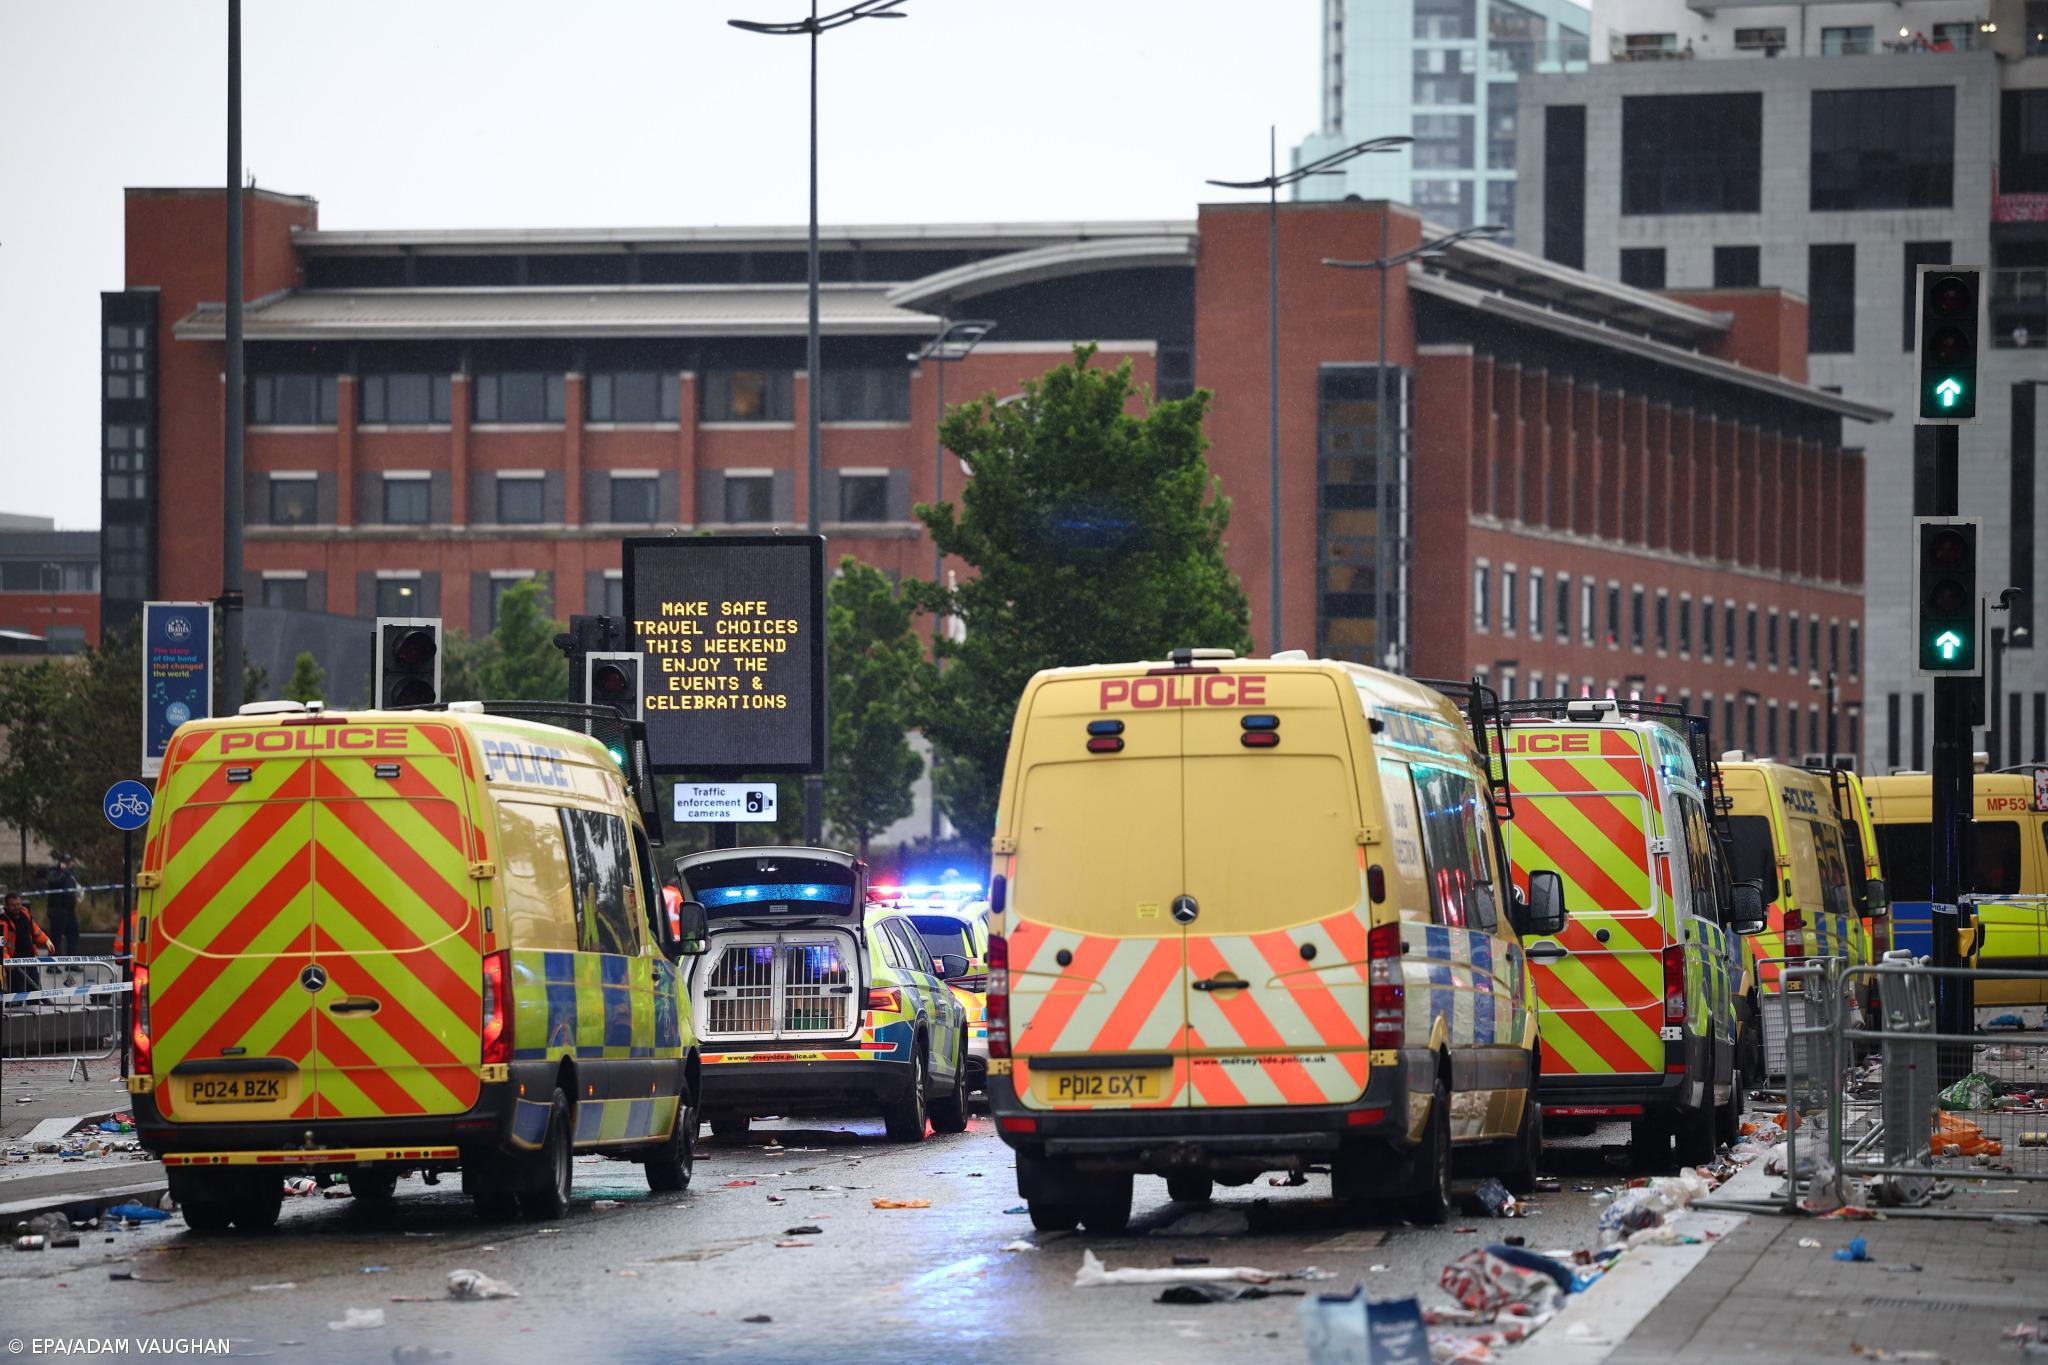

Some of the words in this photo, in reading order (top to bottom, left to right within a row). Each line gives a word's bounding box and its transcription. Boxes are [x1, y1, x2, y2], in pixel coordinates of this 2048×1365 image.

[662, 602, 708, 616] MAKE
[721, 601, 767, 616] SAFE
[634, 620, 703, 635] TRAVEL
[716, 619, 798, 634] CHOICES
[646, 639, 692, 653] THIS
[704, 638, 787, 653] WEEKEND
[171, 663, 204, 671] changed
[662, 658, 720, 672] ENJOY
[733, 657, 768, 671] THE
[153, 670, 166, 678] the
[167, 670, 192, 678] world.
[669, 676, 739, 690] EVENTS
[752, 676, 763, 690] &
[1100, 675, 1266, 711] POLICE
[645, 694, 787, 710] CELEBRATIONS
[220, 728, 408, 754] POLICE
[1491, 733, 1589, 753] LICE
[483, 740, 569, 787] POLICE
[693, 787, 726, 796] Traffic
[677, 798, 741, 807] enforcement
[1784, 786, 1818, 815] POLICE
[688, 810, 731, 818] cameras
[727, 1053, 818, 1061] www.merseyside.police.uk
[1193, 1056, 1326, 1066] www.merseyside.police.uk
[244, 1080, 279, 1097] BZK
[1109, 1075, 1147, 1096] GXT
